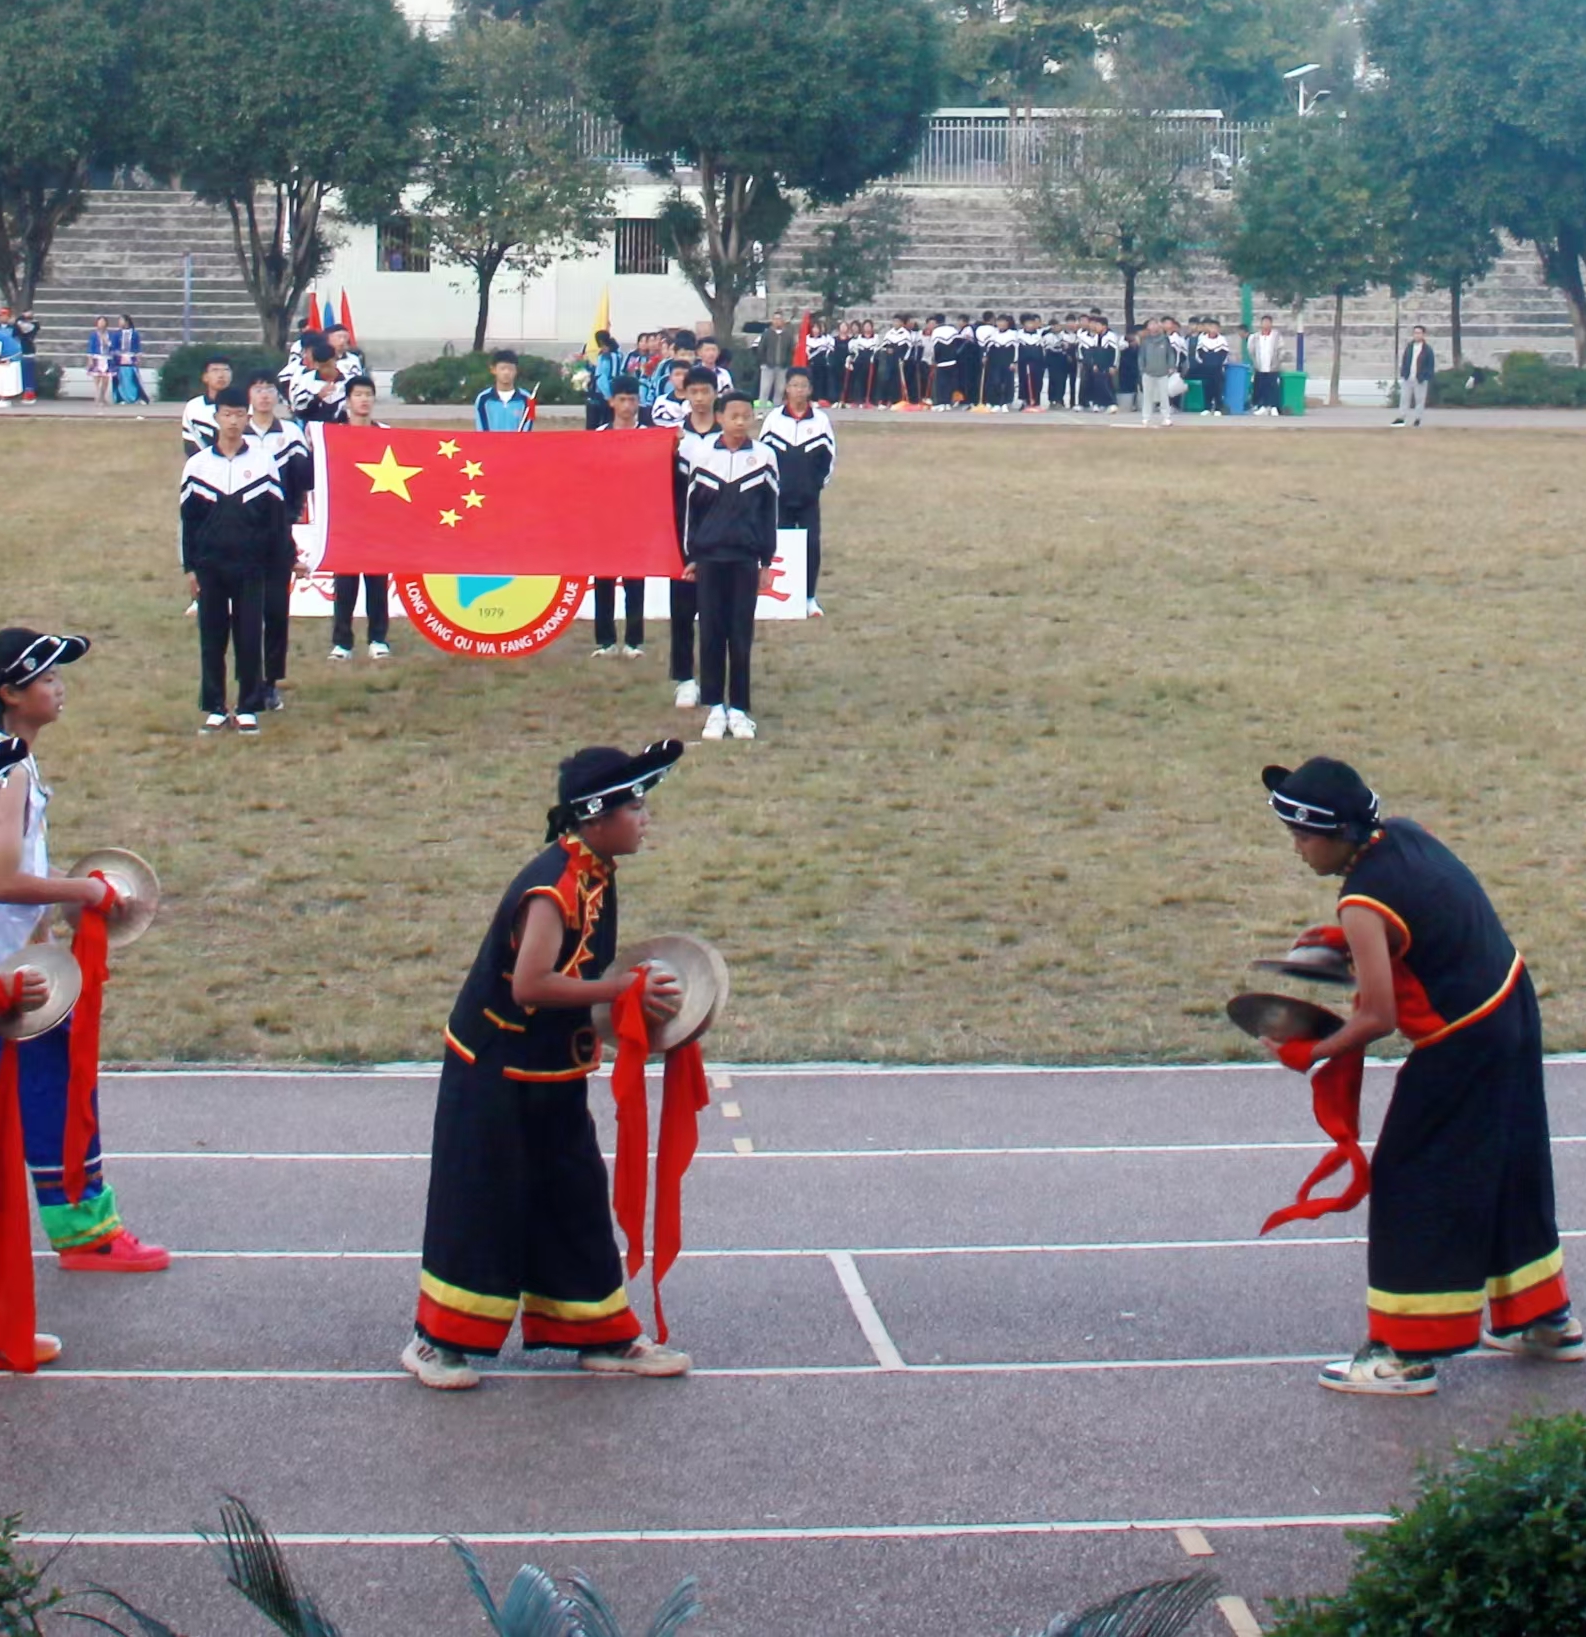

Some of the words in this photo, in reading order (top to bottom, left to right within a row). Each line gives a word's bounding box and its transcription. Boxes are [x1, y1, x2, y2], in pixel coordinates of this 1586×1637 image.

[405, 581, 427, 615] LONG
[423, 612, 453, 642] YANG
[454, 635, 473, 651] QU
[476, 641, 497, 654] WA
[500, 635, 533, 654] FANG
[535, 607, 568, 642] ZHONG
[561, 581, 579, 607] XUE
[478, 607, 505, 618] 1979
